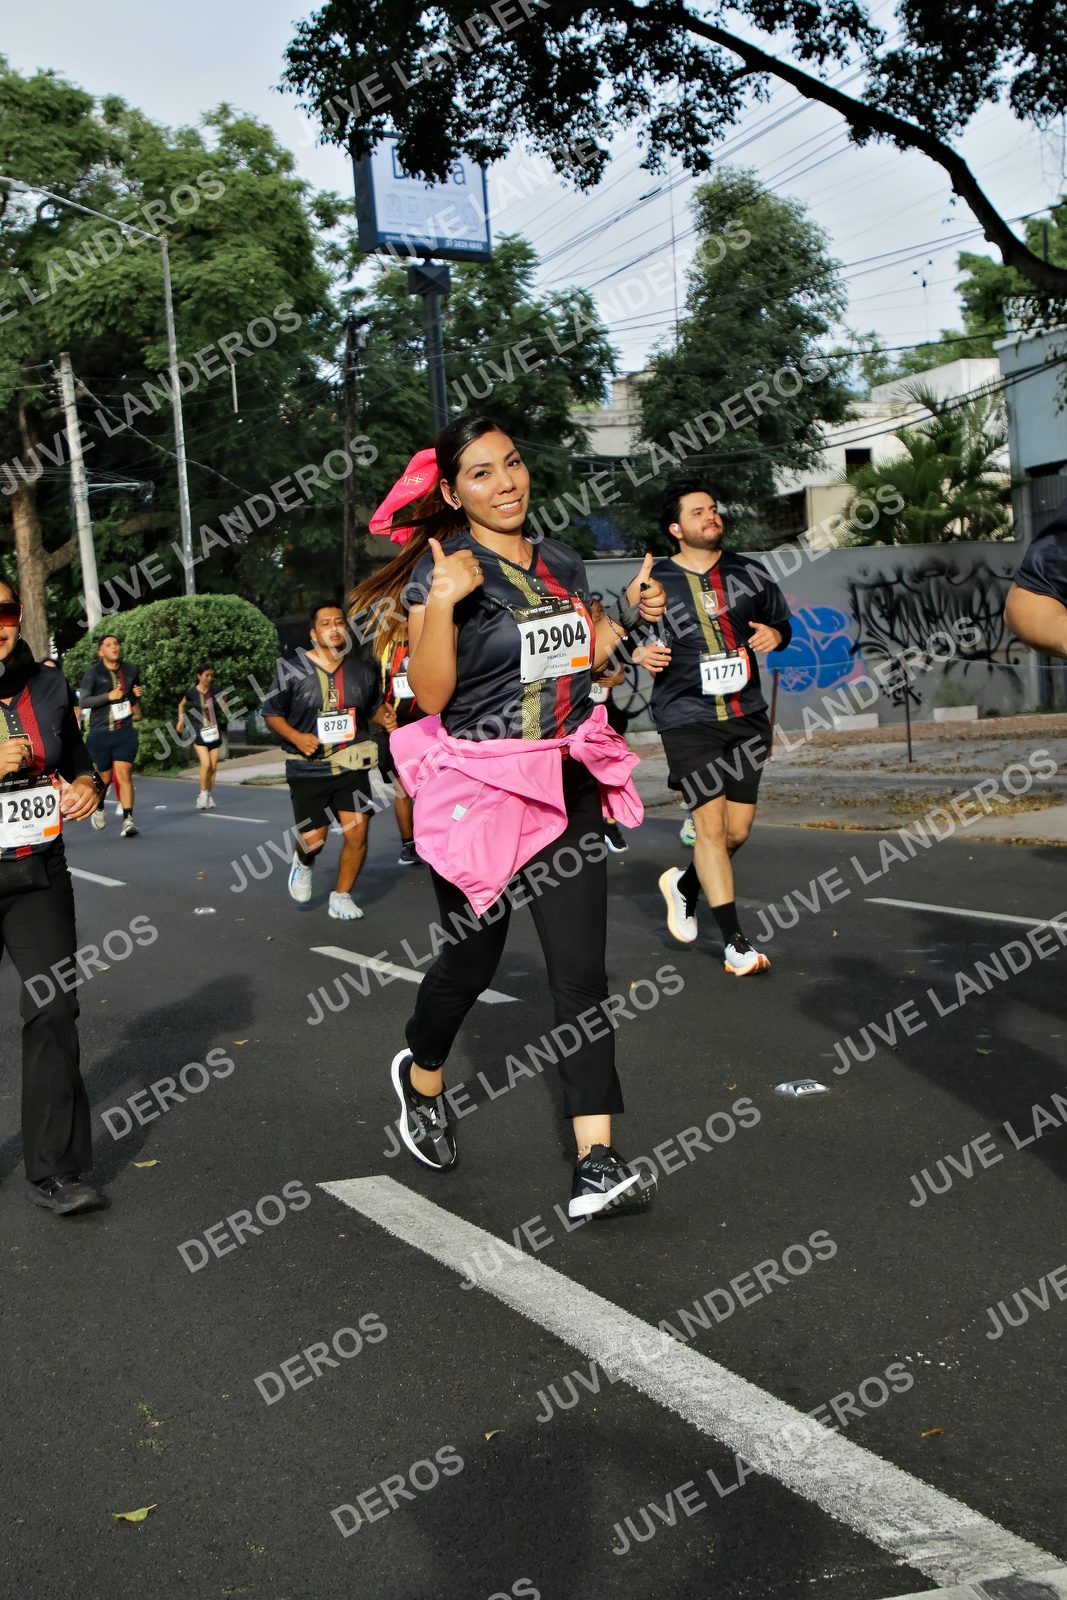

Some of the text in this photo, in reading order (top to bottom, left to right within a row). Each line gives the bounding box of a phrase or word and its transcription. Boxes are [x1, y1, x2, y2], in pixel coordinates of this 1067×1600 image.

[526, 621, 586, 655] 12904
[705, 662, 743, 681] 11771
[324, 719, 348, 731] 8787
